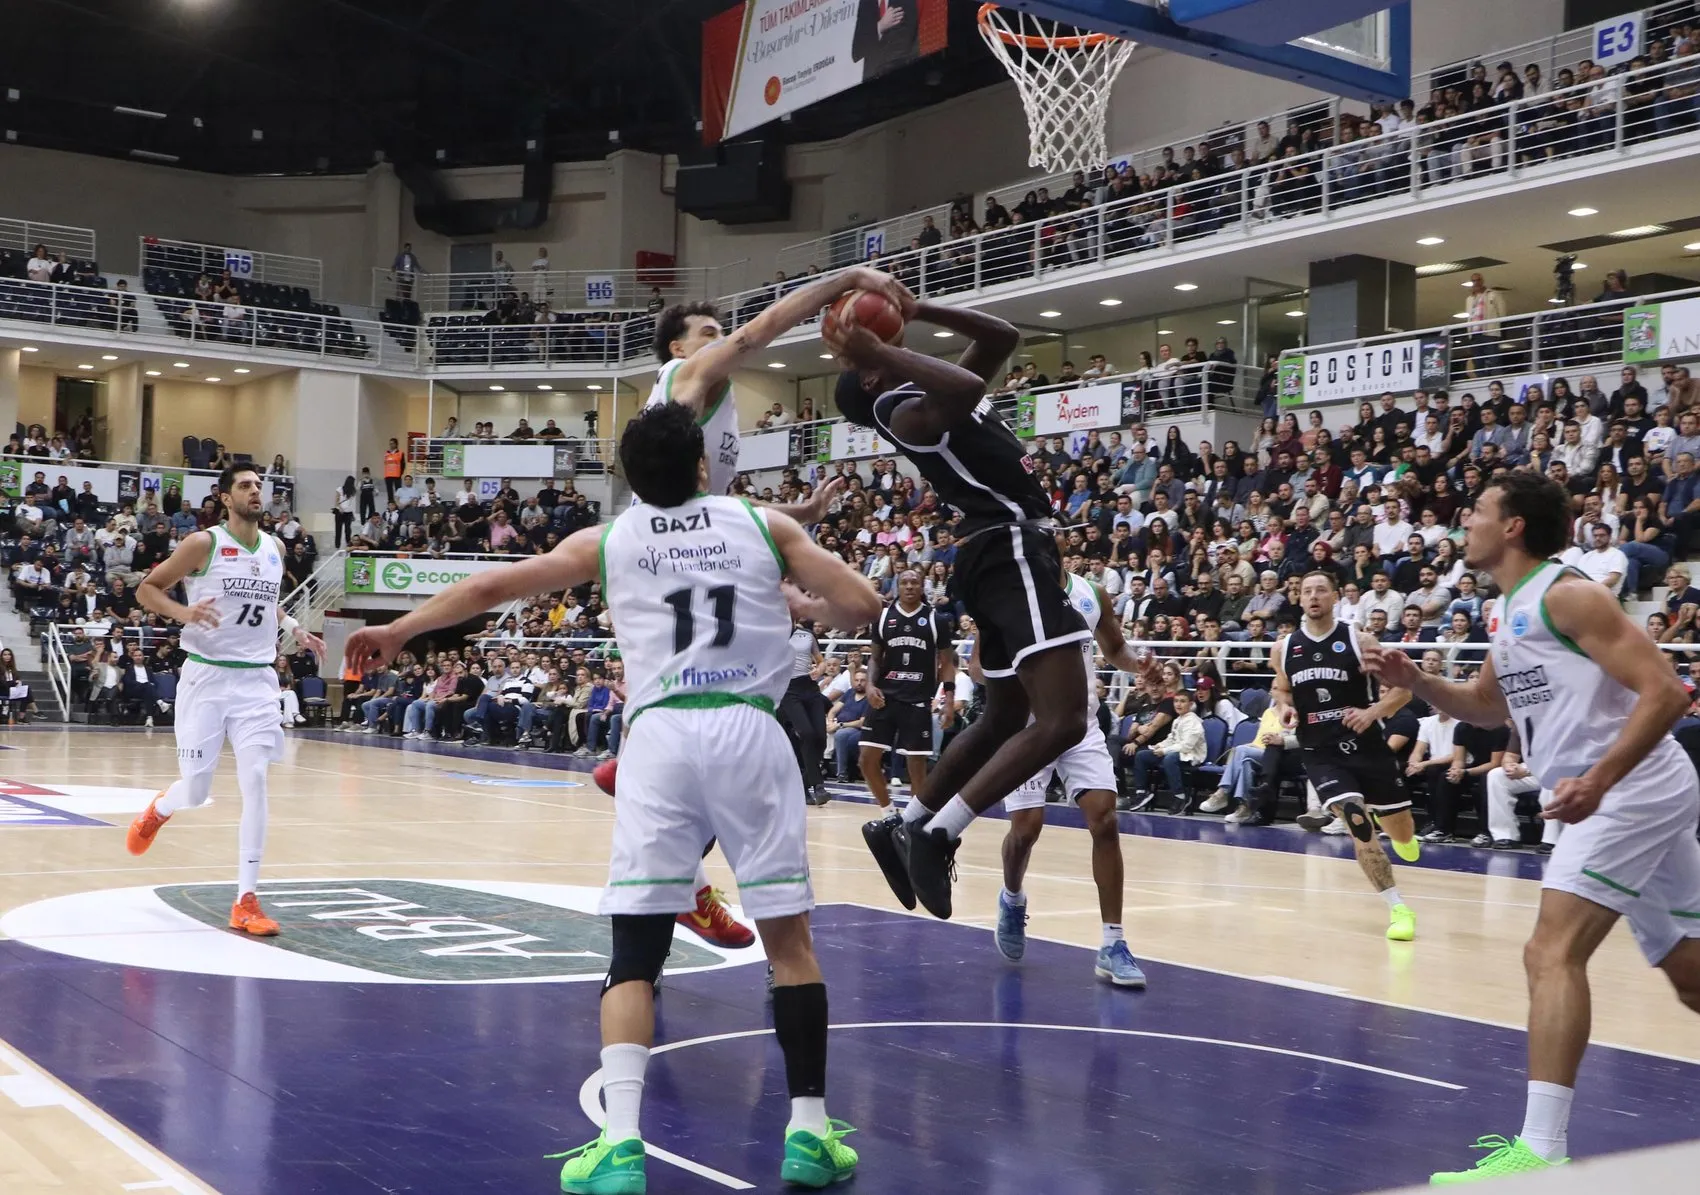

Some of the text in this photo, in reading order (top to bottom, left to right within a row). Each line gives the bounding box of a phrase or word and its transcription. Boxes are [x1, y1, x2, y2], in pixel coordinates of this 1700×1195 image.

[760, 10, 778, 34] TÜM
[1596, 21, 1635, 60] E3
[226, 253, 252, 274] H5
[588, 280, 613, 300] H6
[1309, 346, 1414, 387] BOSTON
[1058, 404, 1099, 424] Aydem
[143, 477, 160, 491] D4
[481, 481, 499, 494] D5
[651, 507, 712, 534] GAZİ
[669, 542, 727, 560] Denipol
[672, 555, 742, 572] Hastanesi
[236, 603, 266, 627] 15
[663, 584, 738, 655] 11
[1291, 667, 1349, 687] PRIEVIDZA
